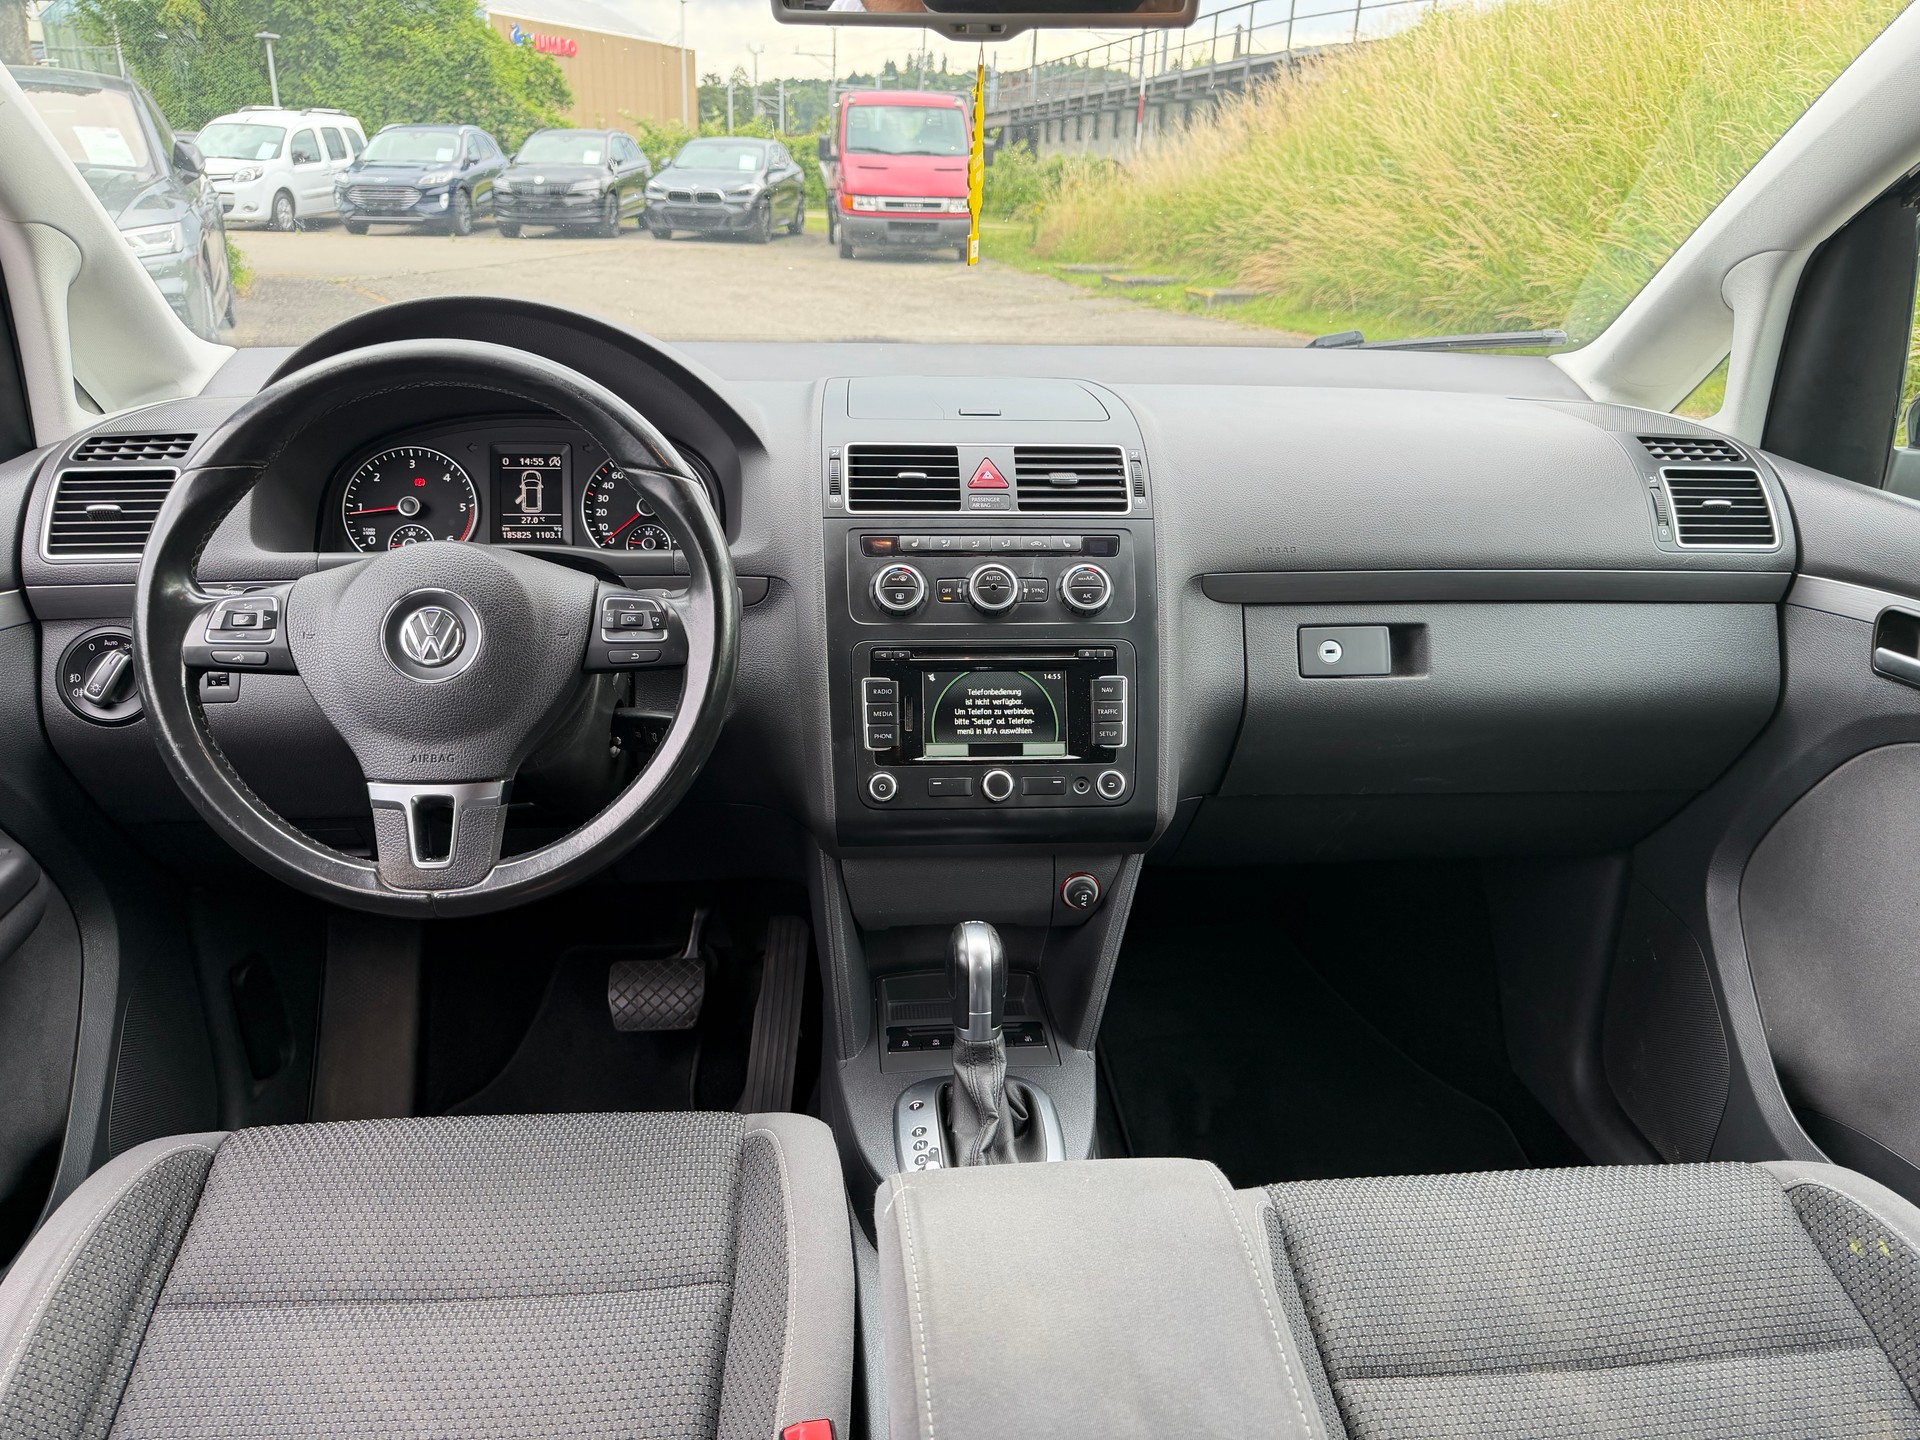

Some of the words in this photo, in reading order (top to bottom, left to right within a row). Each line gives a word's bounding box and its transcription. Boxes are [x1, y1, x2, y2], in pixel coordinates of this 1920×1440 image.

[409, 460, 416, 469] 3
[519, 457, 545, 466] 14:55
[373, 473, 380, 482] 2
[442, 473, 451, 482] 4
[611, 471, 624, 480] 60
[602, 481, 615, 489] 40
[597, 494, 609, 502] 30
[459, 503, 466, 512] 5
[595, 508, 608, 516] 20
[521, 516, 539, 524] 27.0
[598, 523, 609, 531] 10
[502, 531, 532, 539] 185825
[535, 531, 562, 539] 1103.1
[367, 536, 376, 545] 0
[967, 688, 1022, 697] Telefonbedienung
[965, 698, 973, 706] ist
[975, 698, 990, 706] nicht
[954, 708, 966, 716] Um
[968, 708, 992, 716] Telefon
[410, 754, 455, 763] AIRBAG
